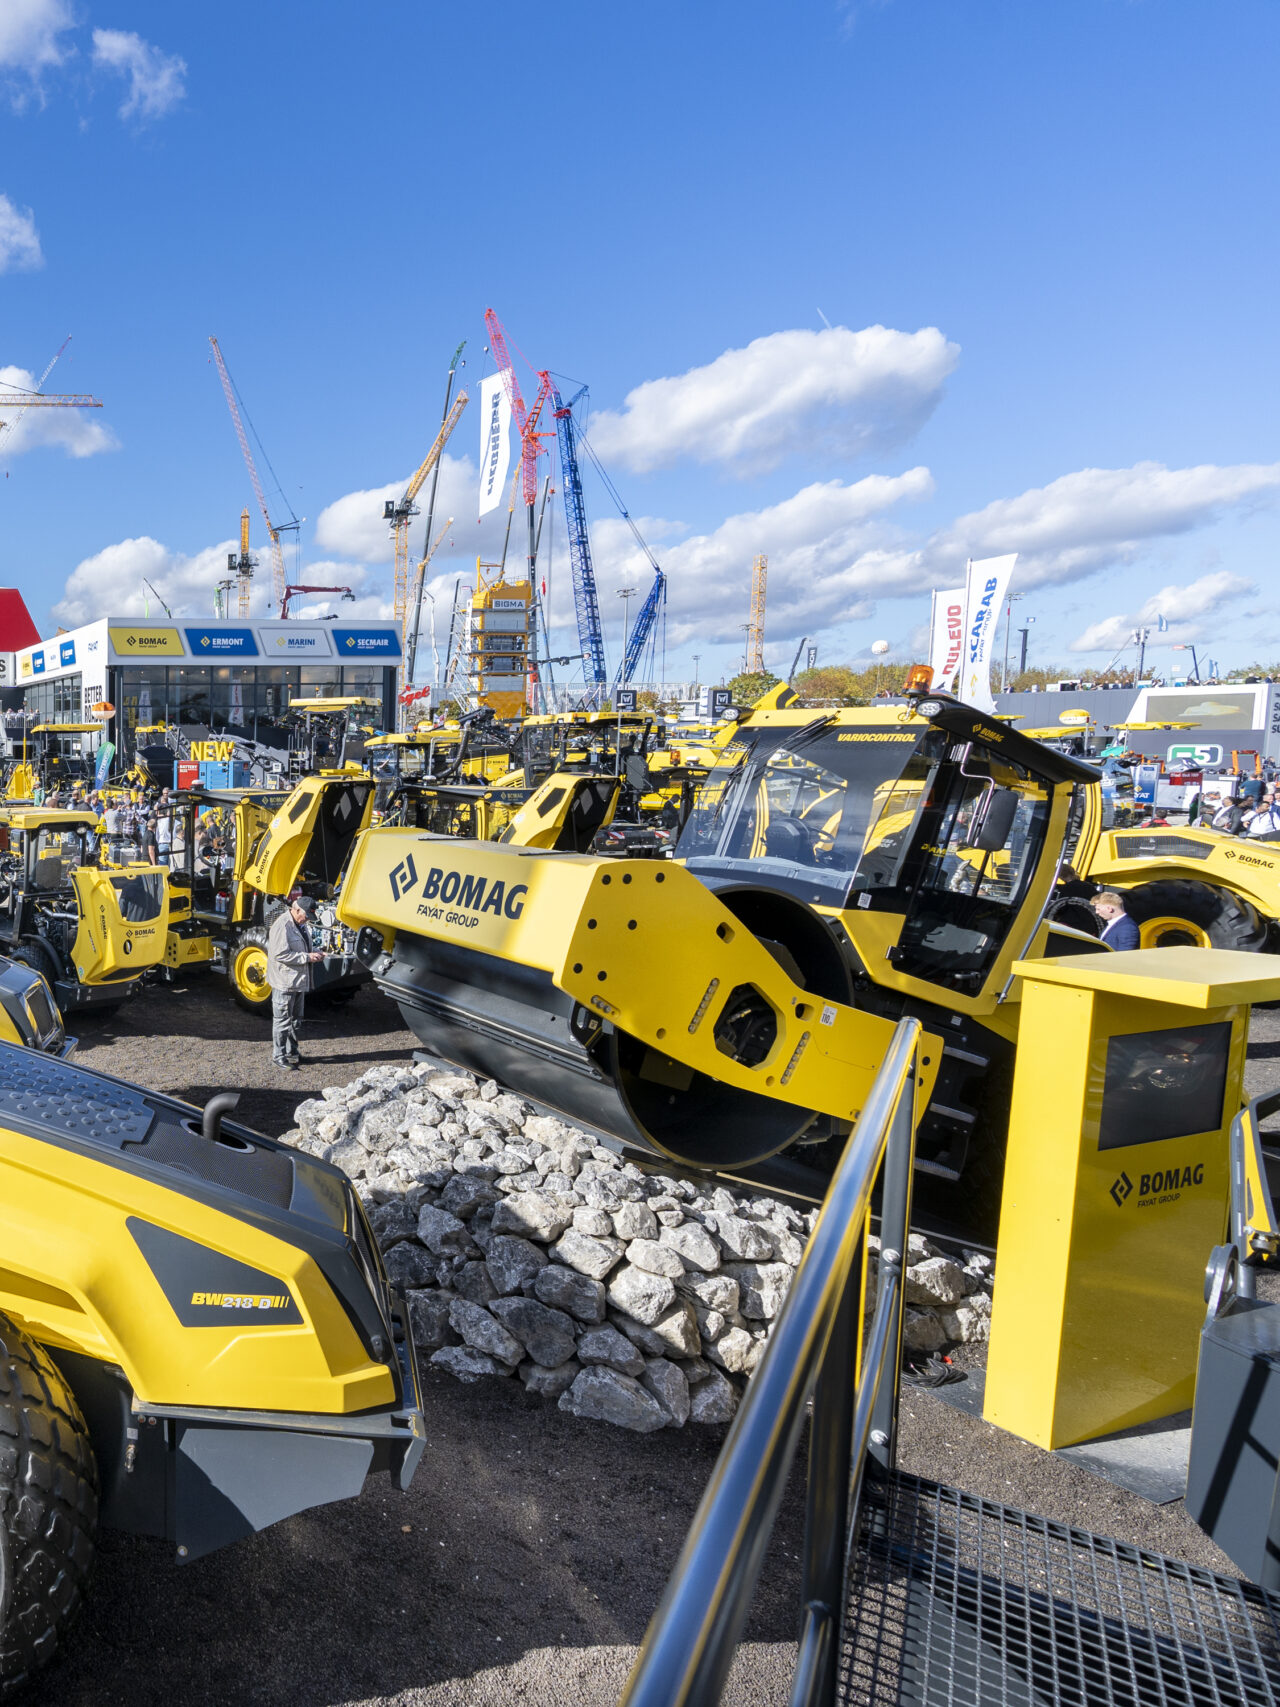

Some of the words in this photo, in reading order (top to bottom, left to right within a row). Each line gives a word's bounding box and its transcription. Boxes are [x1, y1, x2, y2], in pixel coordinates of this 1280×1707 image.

[970, 577, 997, 663] SCARAB
[138, 637, 167, 645] BOMAG
[287, 638, 315, 646] MARINI
[357, 638, 389, 646] SECMAIR
[84, 685, 103, 704] BETTER
[837, 733, 916, 742] VARIOCONTROL
[980, 727, 1005, 743] BOMAG
[190, 741, 235, 761] NEW
[259, 850, 269, 874] BOMAG
[1239, 855, 1275, 869] BOMAG
[422, 867, 529, 920] BOMAG
[416, 904, 445, 921] FAYAT
[445, 911, 479, 929] GROUP
[134, 928, 156, 936] BOMAG
[1138, 1163, 1205, 1196] BOMAG
[1136, 1196, 1157, 1208] FAYAT
[1158, 1192, 1181, 1205] GROUP
[222, 1296, 254, 1309] 218
